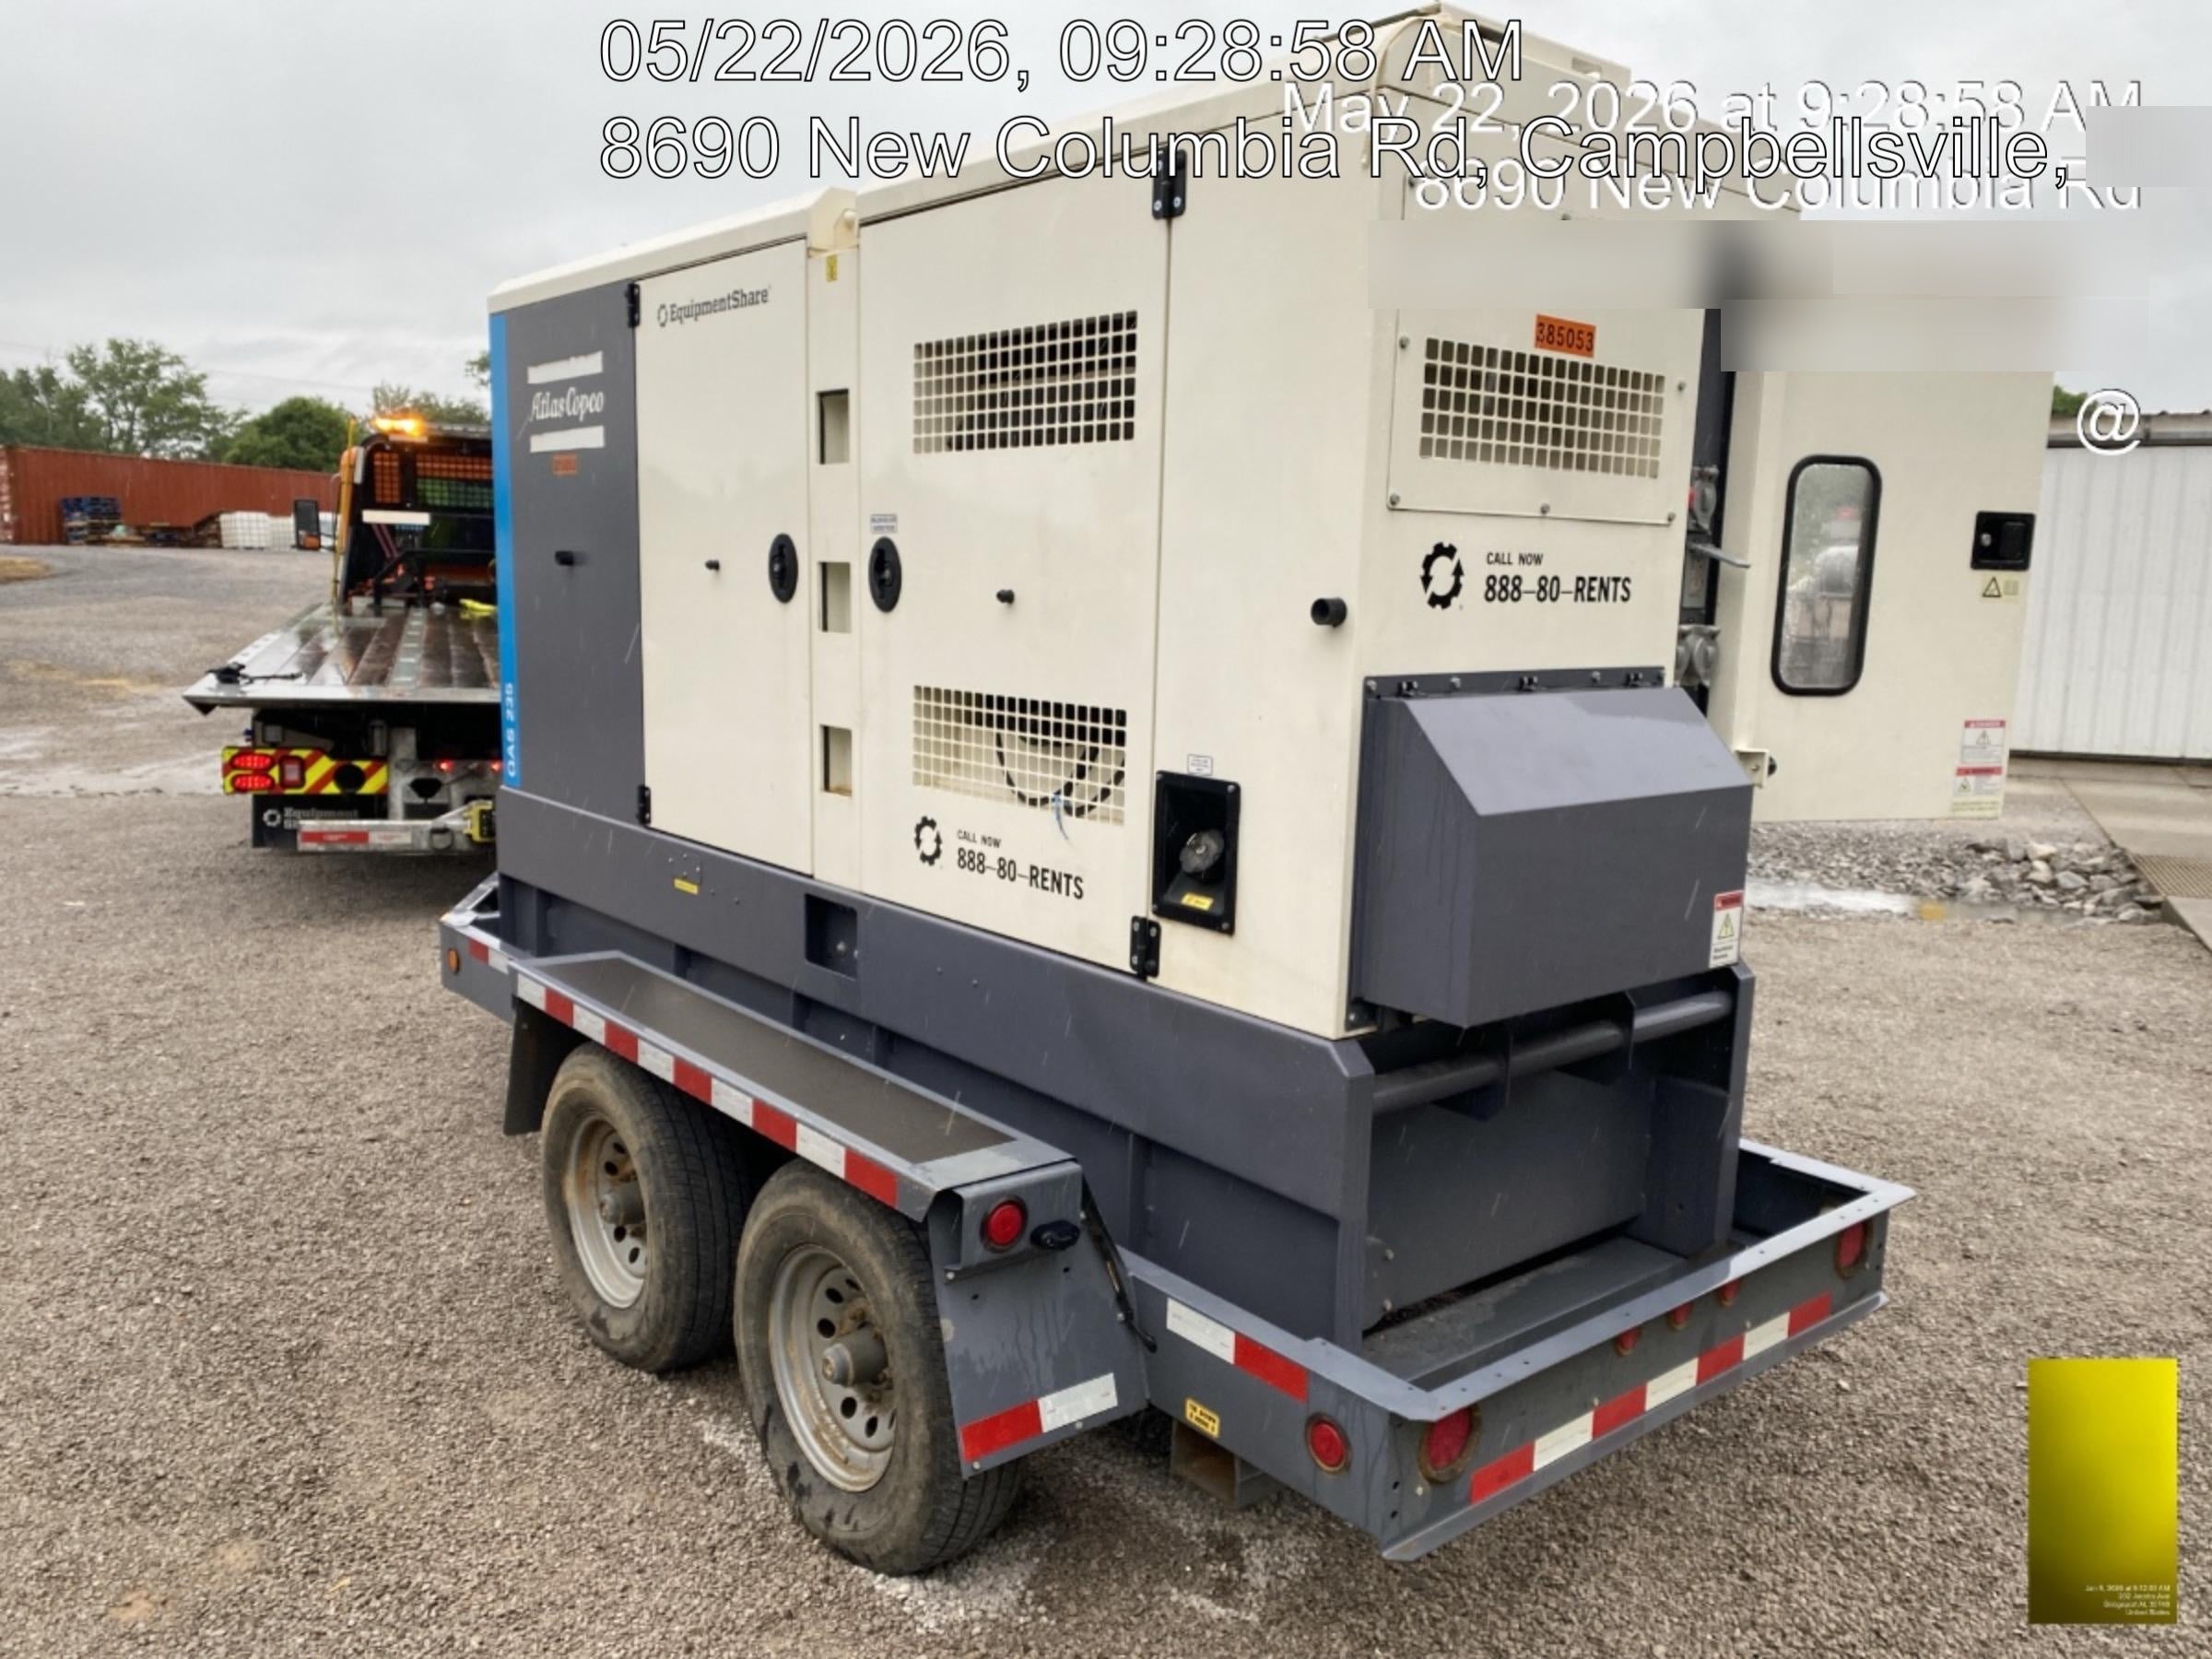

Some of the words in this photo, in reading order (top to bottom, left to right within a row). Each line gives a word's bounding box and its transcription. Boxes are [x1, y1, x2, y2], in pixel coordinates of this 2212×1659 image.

[669, 288, 769, 324] EquipmentShare
[1535, 322, 1594, 352] 385053
[531, 391, 564, 421] Atlas
[564, 386, 605, 422] Copco
[1487, 552, 1512, 565] CALL
[1519, 553, 1544, 565] NOW
[1485, 575, 1631, 603] 888-80-RENTS
[957, 829, 977, 843] CALL
[981, 835, 1002, 848] NOW
[958, 847, 1084, 900] 888-80-RENTS
